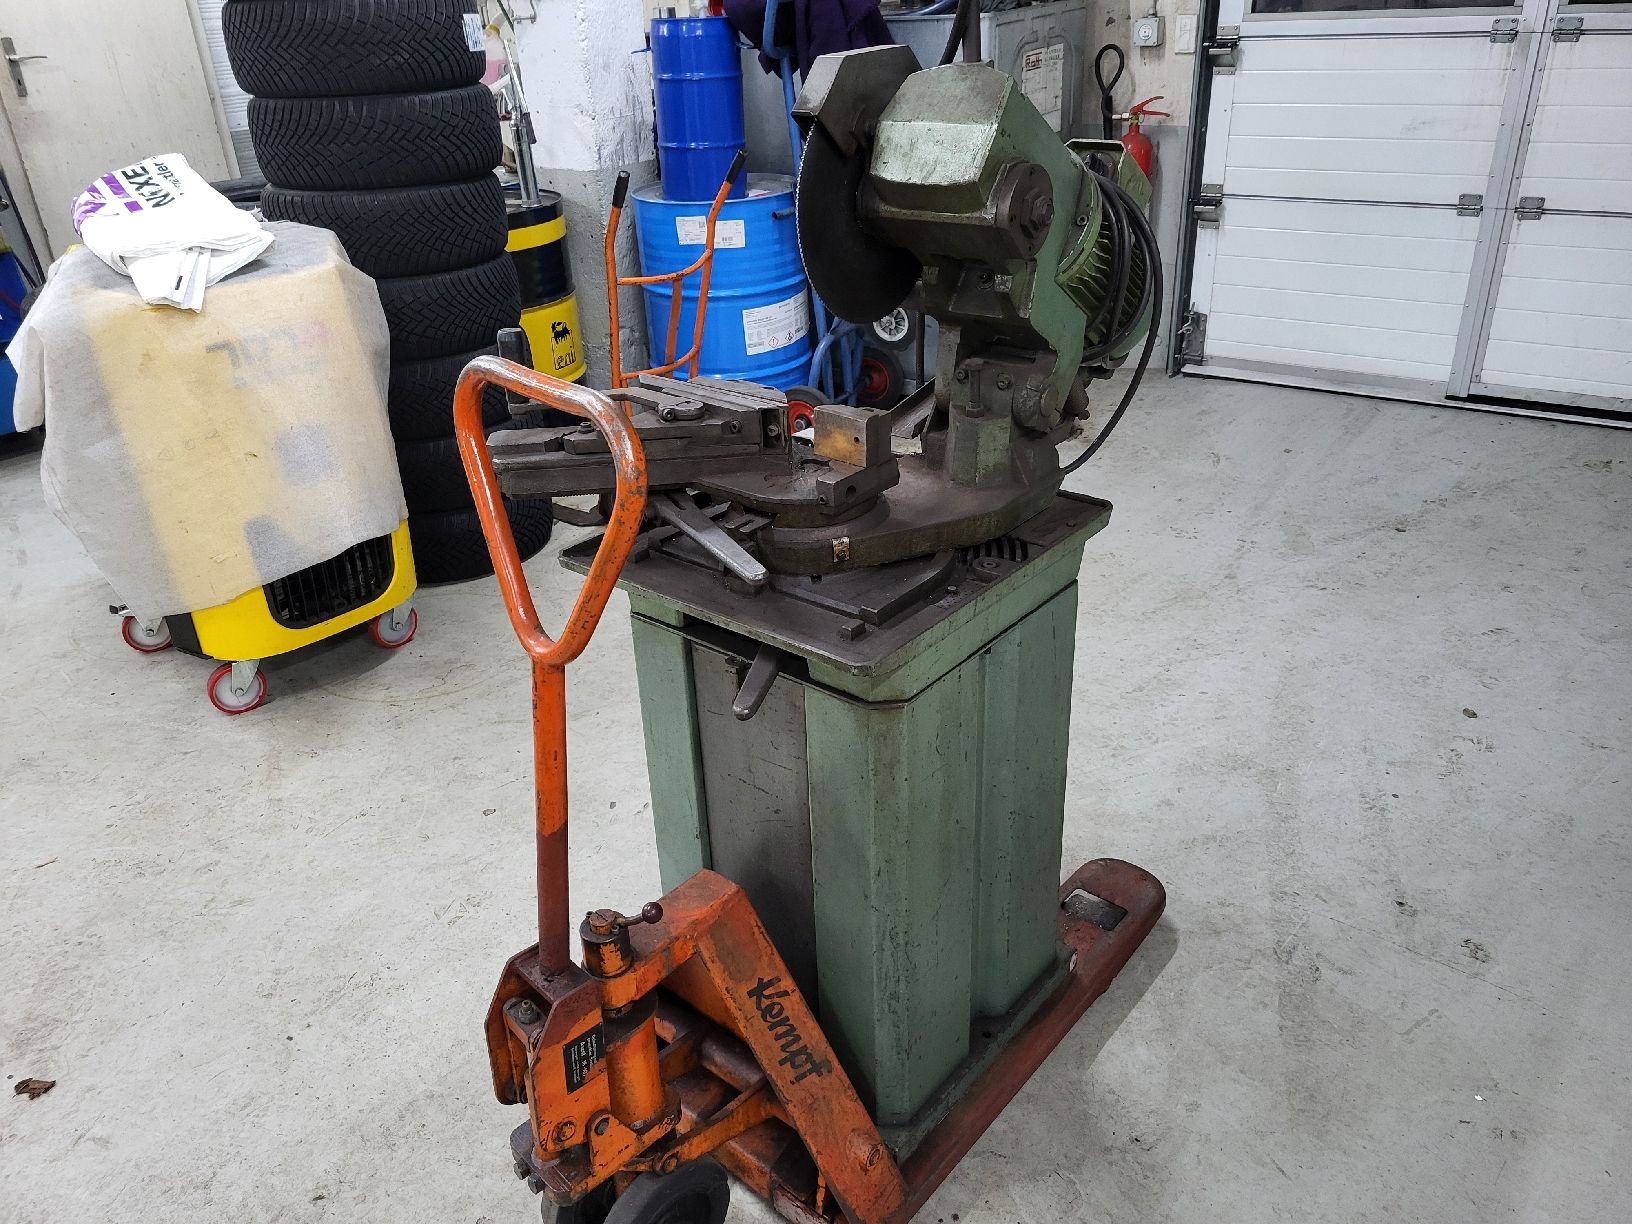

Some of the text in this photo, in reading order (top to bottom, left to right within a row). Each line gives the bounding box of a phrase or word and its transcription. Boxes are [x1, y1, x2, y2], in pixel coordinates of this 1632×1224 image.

[121, 164, 176, 208] NEXE
[557, 345, 576, 368] eni
[747, 976, 832, 1082] Kempf
